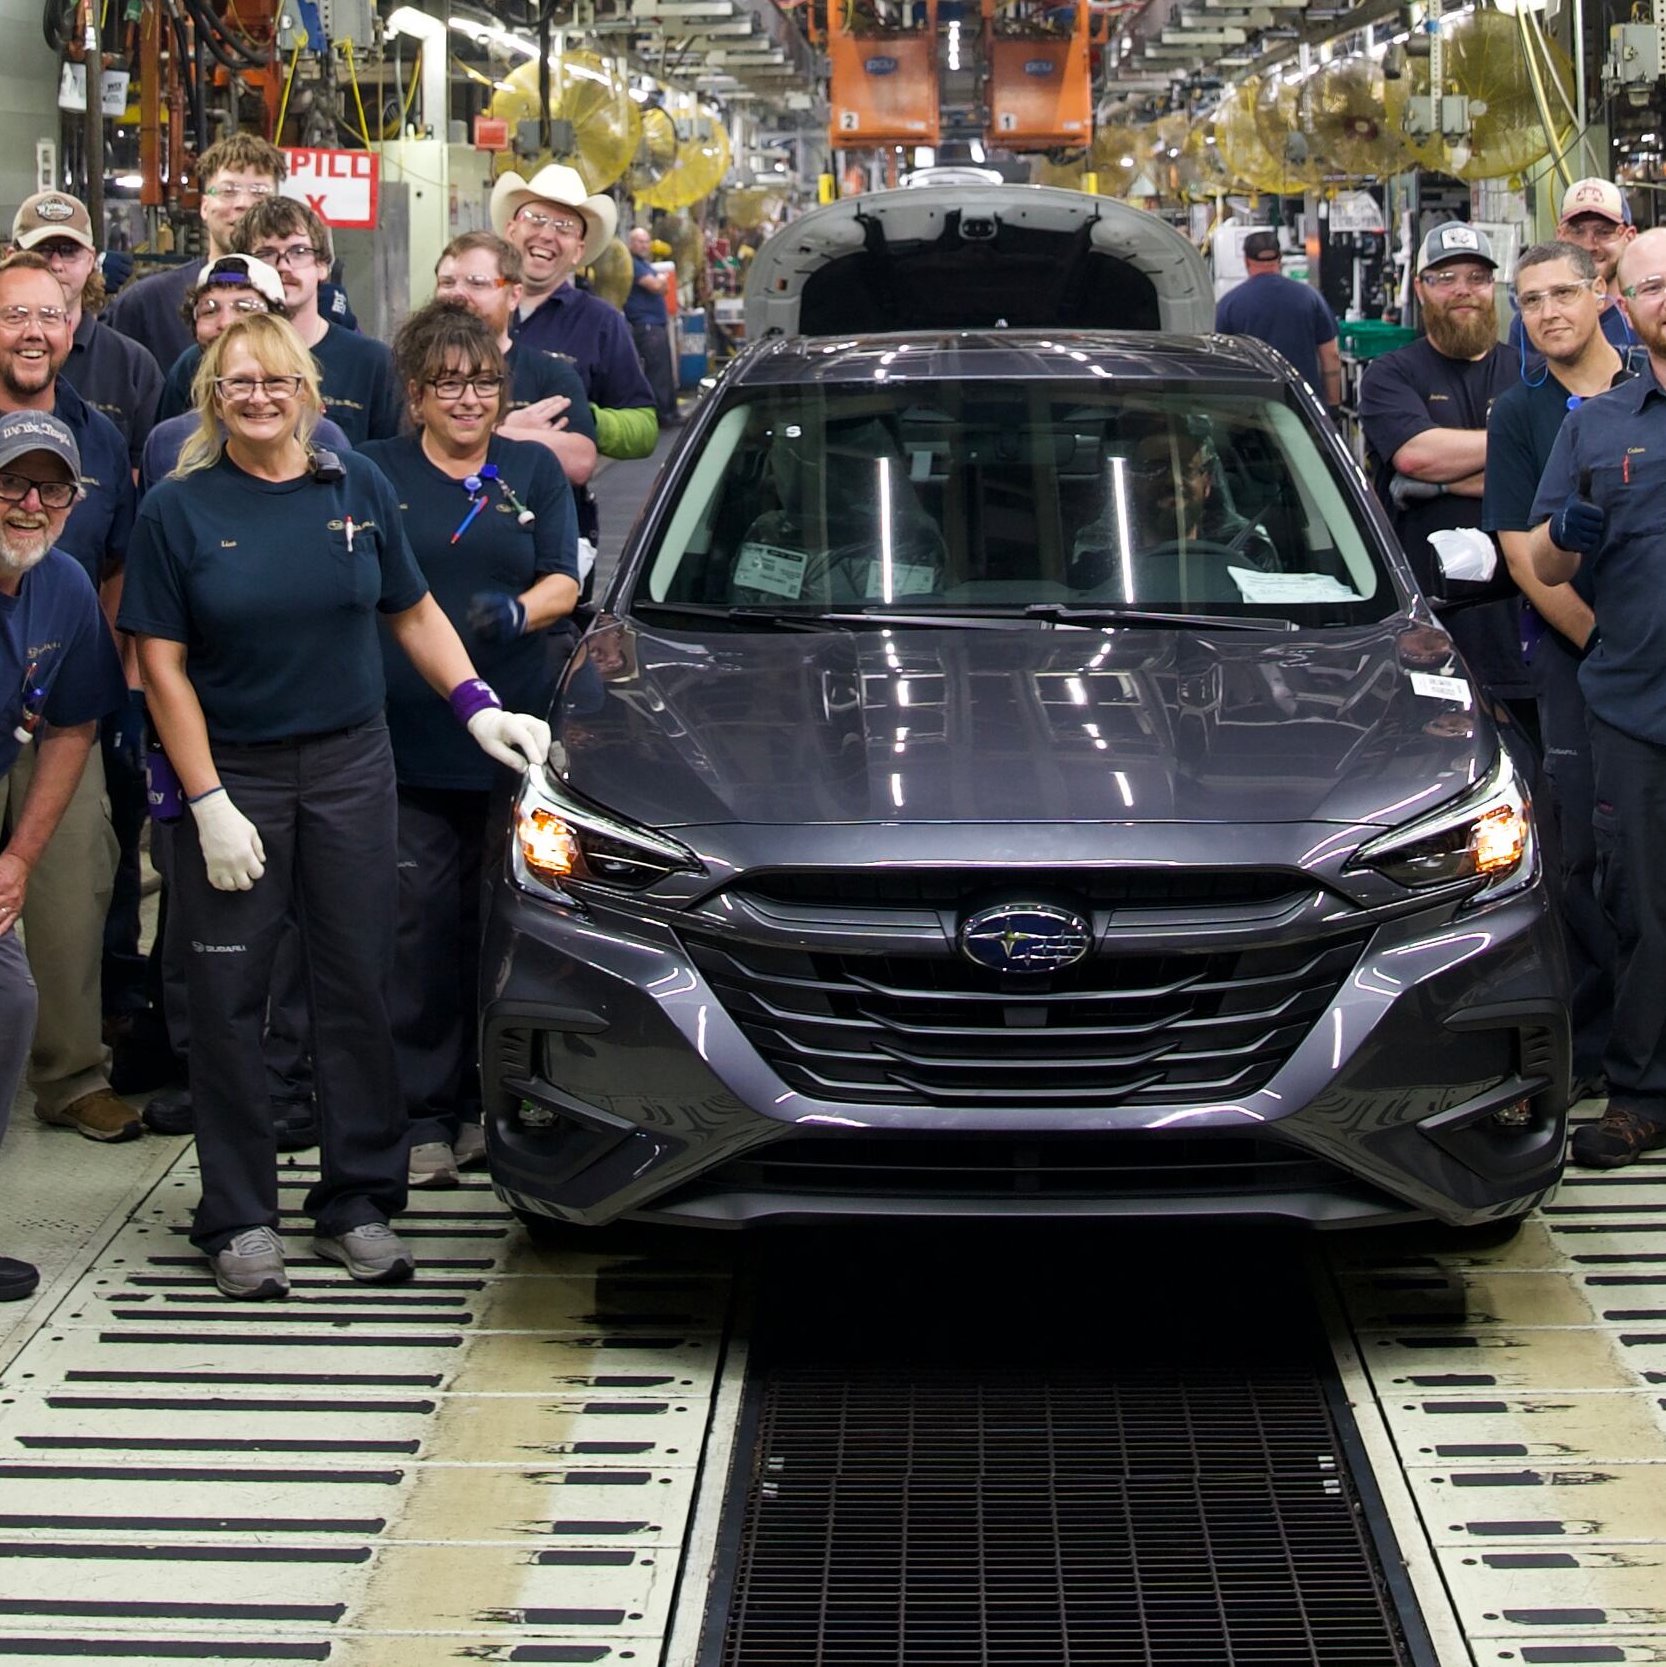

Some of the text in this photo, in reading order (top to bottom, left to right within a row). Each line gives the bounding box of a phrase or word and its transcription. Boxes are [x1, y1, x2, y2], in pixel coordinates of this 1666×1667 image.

[844, 114, 854, 130] 2
[1004, 116, 1012, 130] 1
[287, 152, 372, 179] PILL
